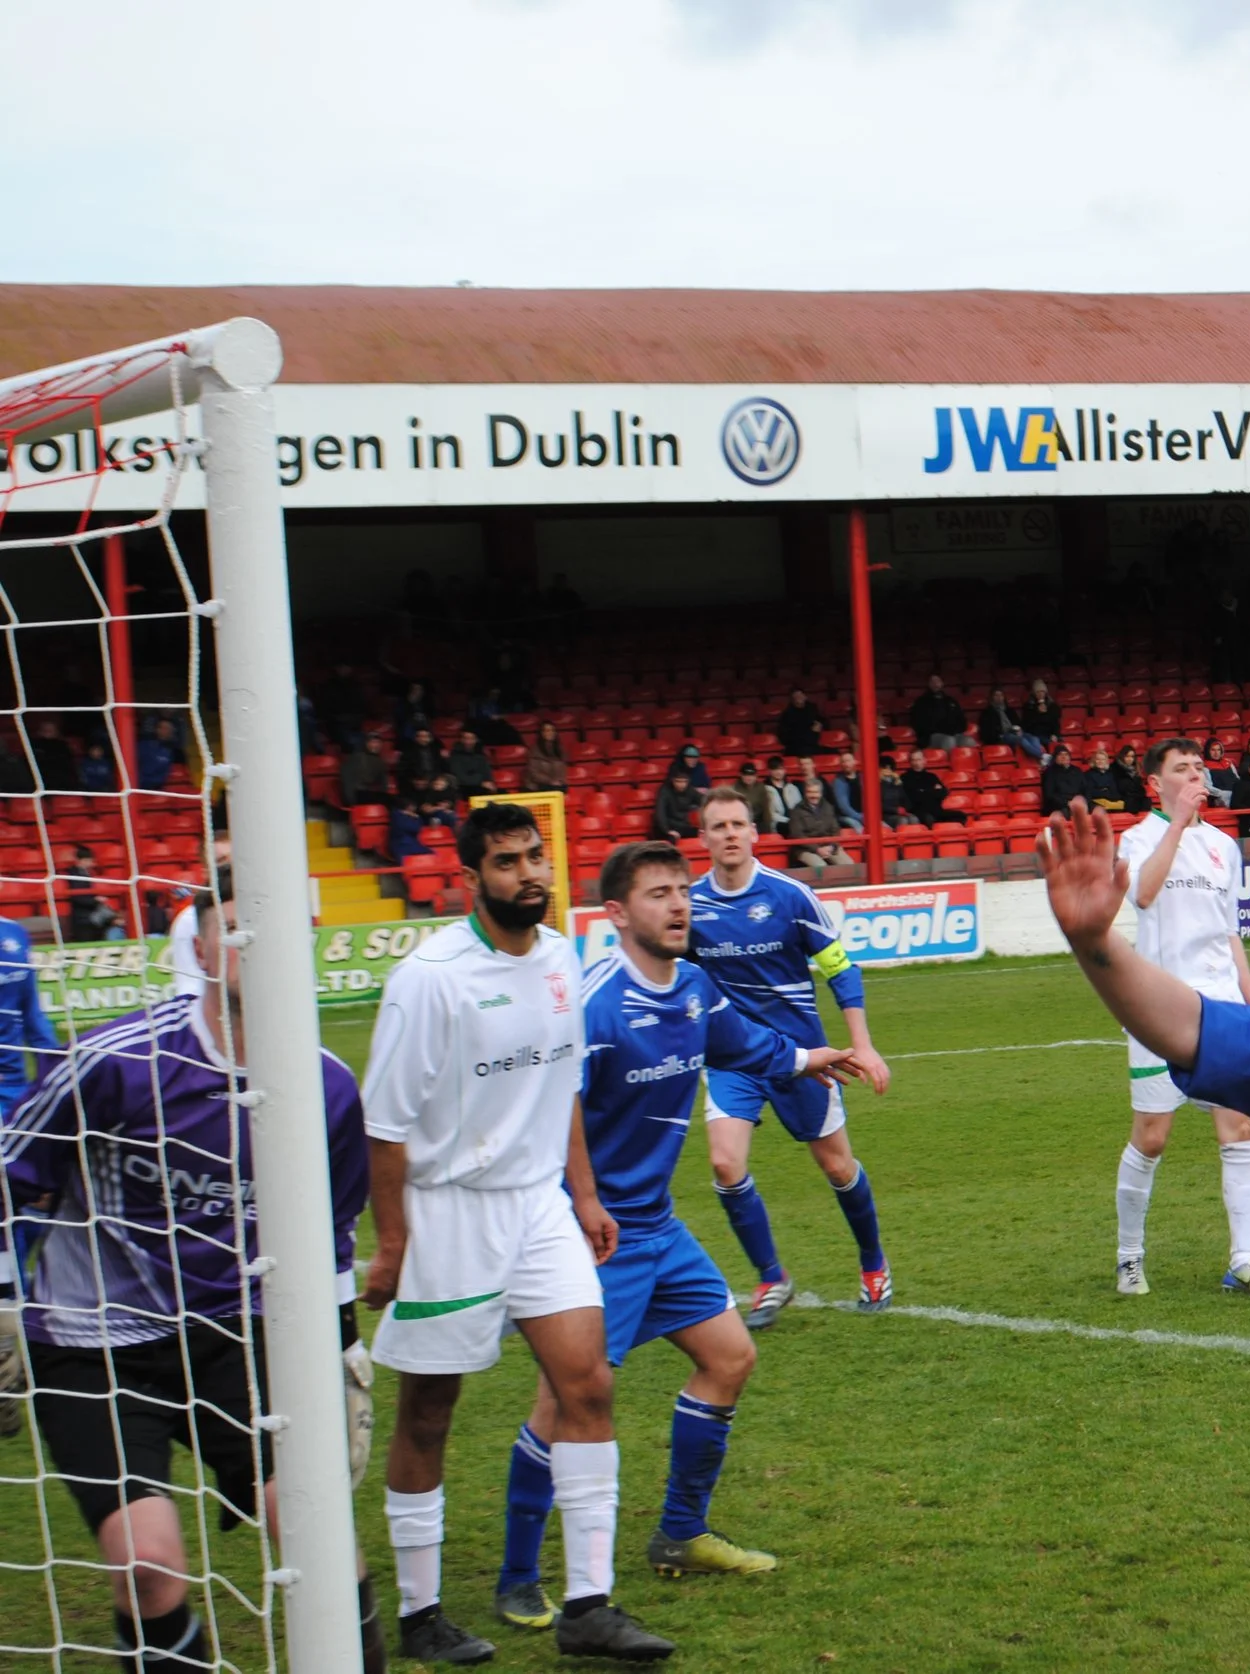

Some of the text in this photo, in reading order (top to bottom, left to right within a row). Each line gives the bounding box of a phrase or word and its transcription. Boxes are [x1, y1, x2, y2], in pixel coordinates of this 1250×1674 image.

[408, 415, 462, 469] in
[488, 410, 682, 469] Dublin
[844, 892, 936, 910] Northside
